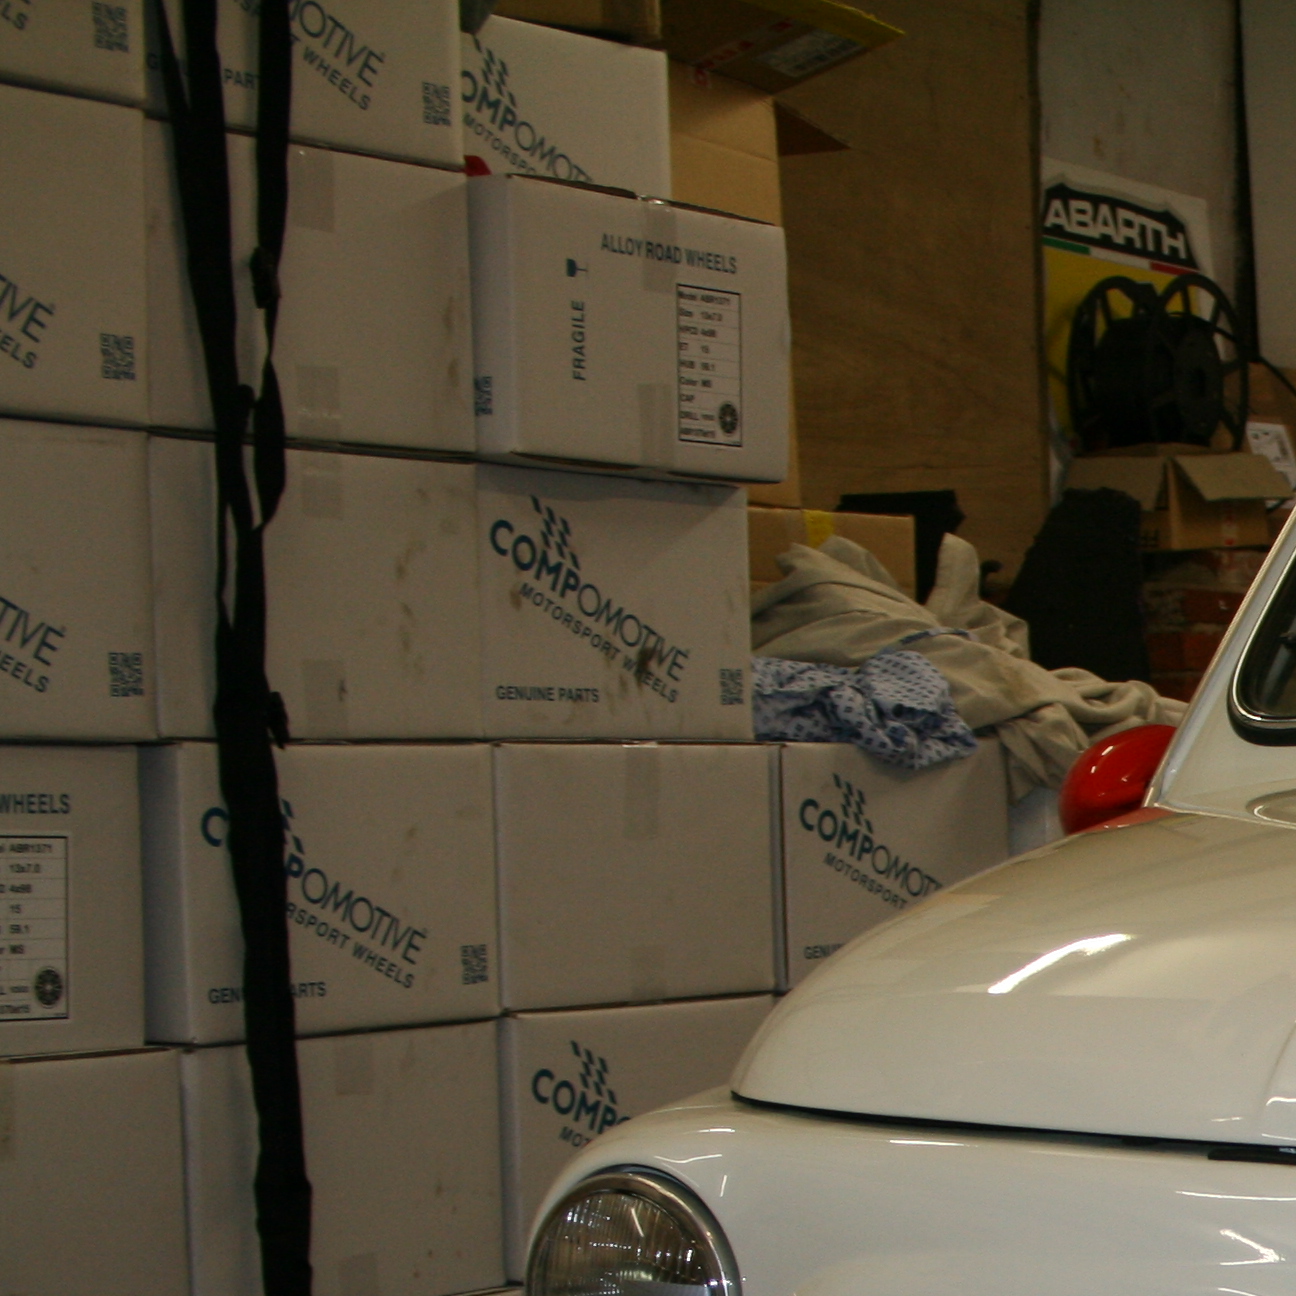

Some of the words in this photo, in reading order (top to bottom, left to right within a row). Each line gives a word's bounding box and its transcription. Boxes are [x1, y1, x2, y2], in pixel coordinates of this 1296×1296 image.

[303, 47, 372, 111] WHEELS
[601, 233, 644, 256] ALLOY
[646, 240, 682, 264] ROAD
[685, 247, 738, 274] WHEELS
[1044, 199, 1188, 260] ABARTH
[571, 300, 587, 381] FRAGILE
[490, 519, 689, 682] COMPOMOTIVE
[519, 582, 621, 660] MOTORSPORT
[622, 655, 680, 703] WEELS
[495, 686, 555, 701] GENUINE
[558, 688, 600, 702] PARTS
[351, 940, 415, 989] WHEELS
